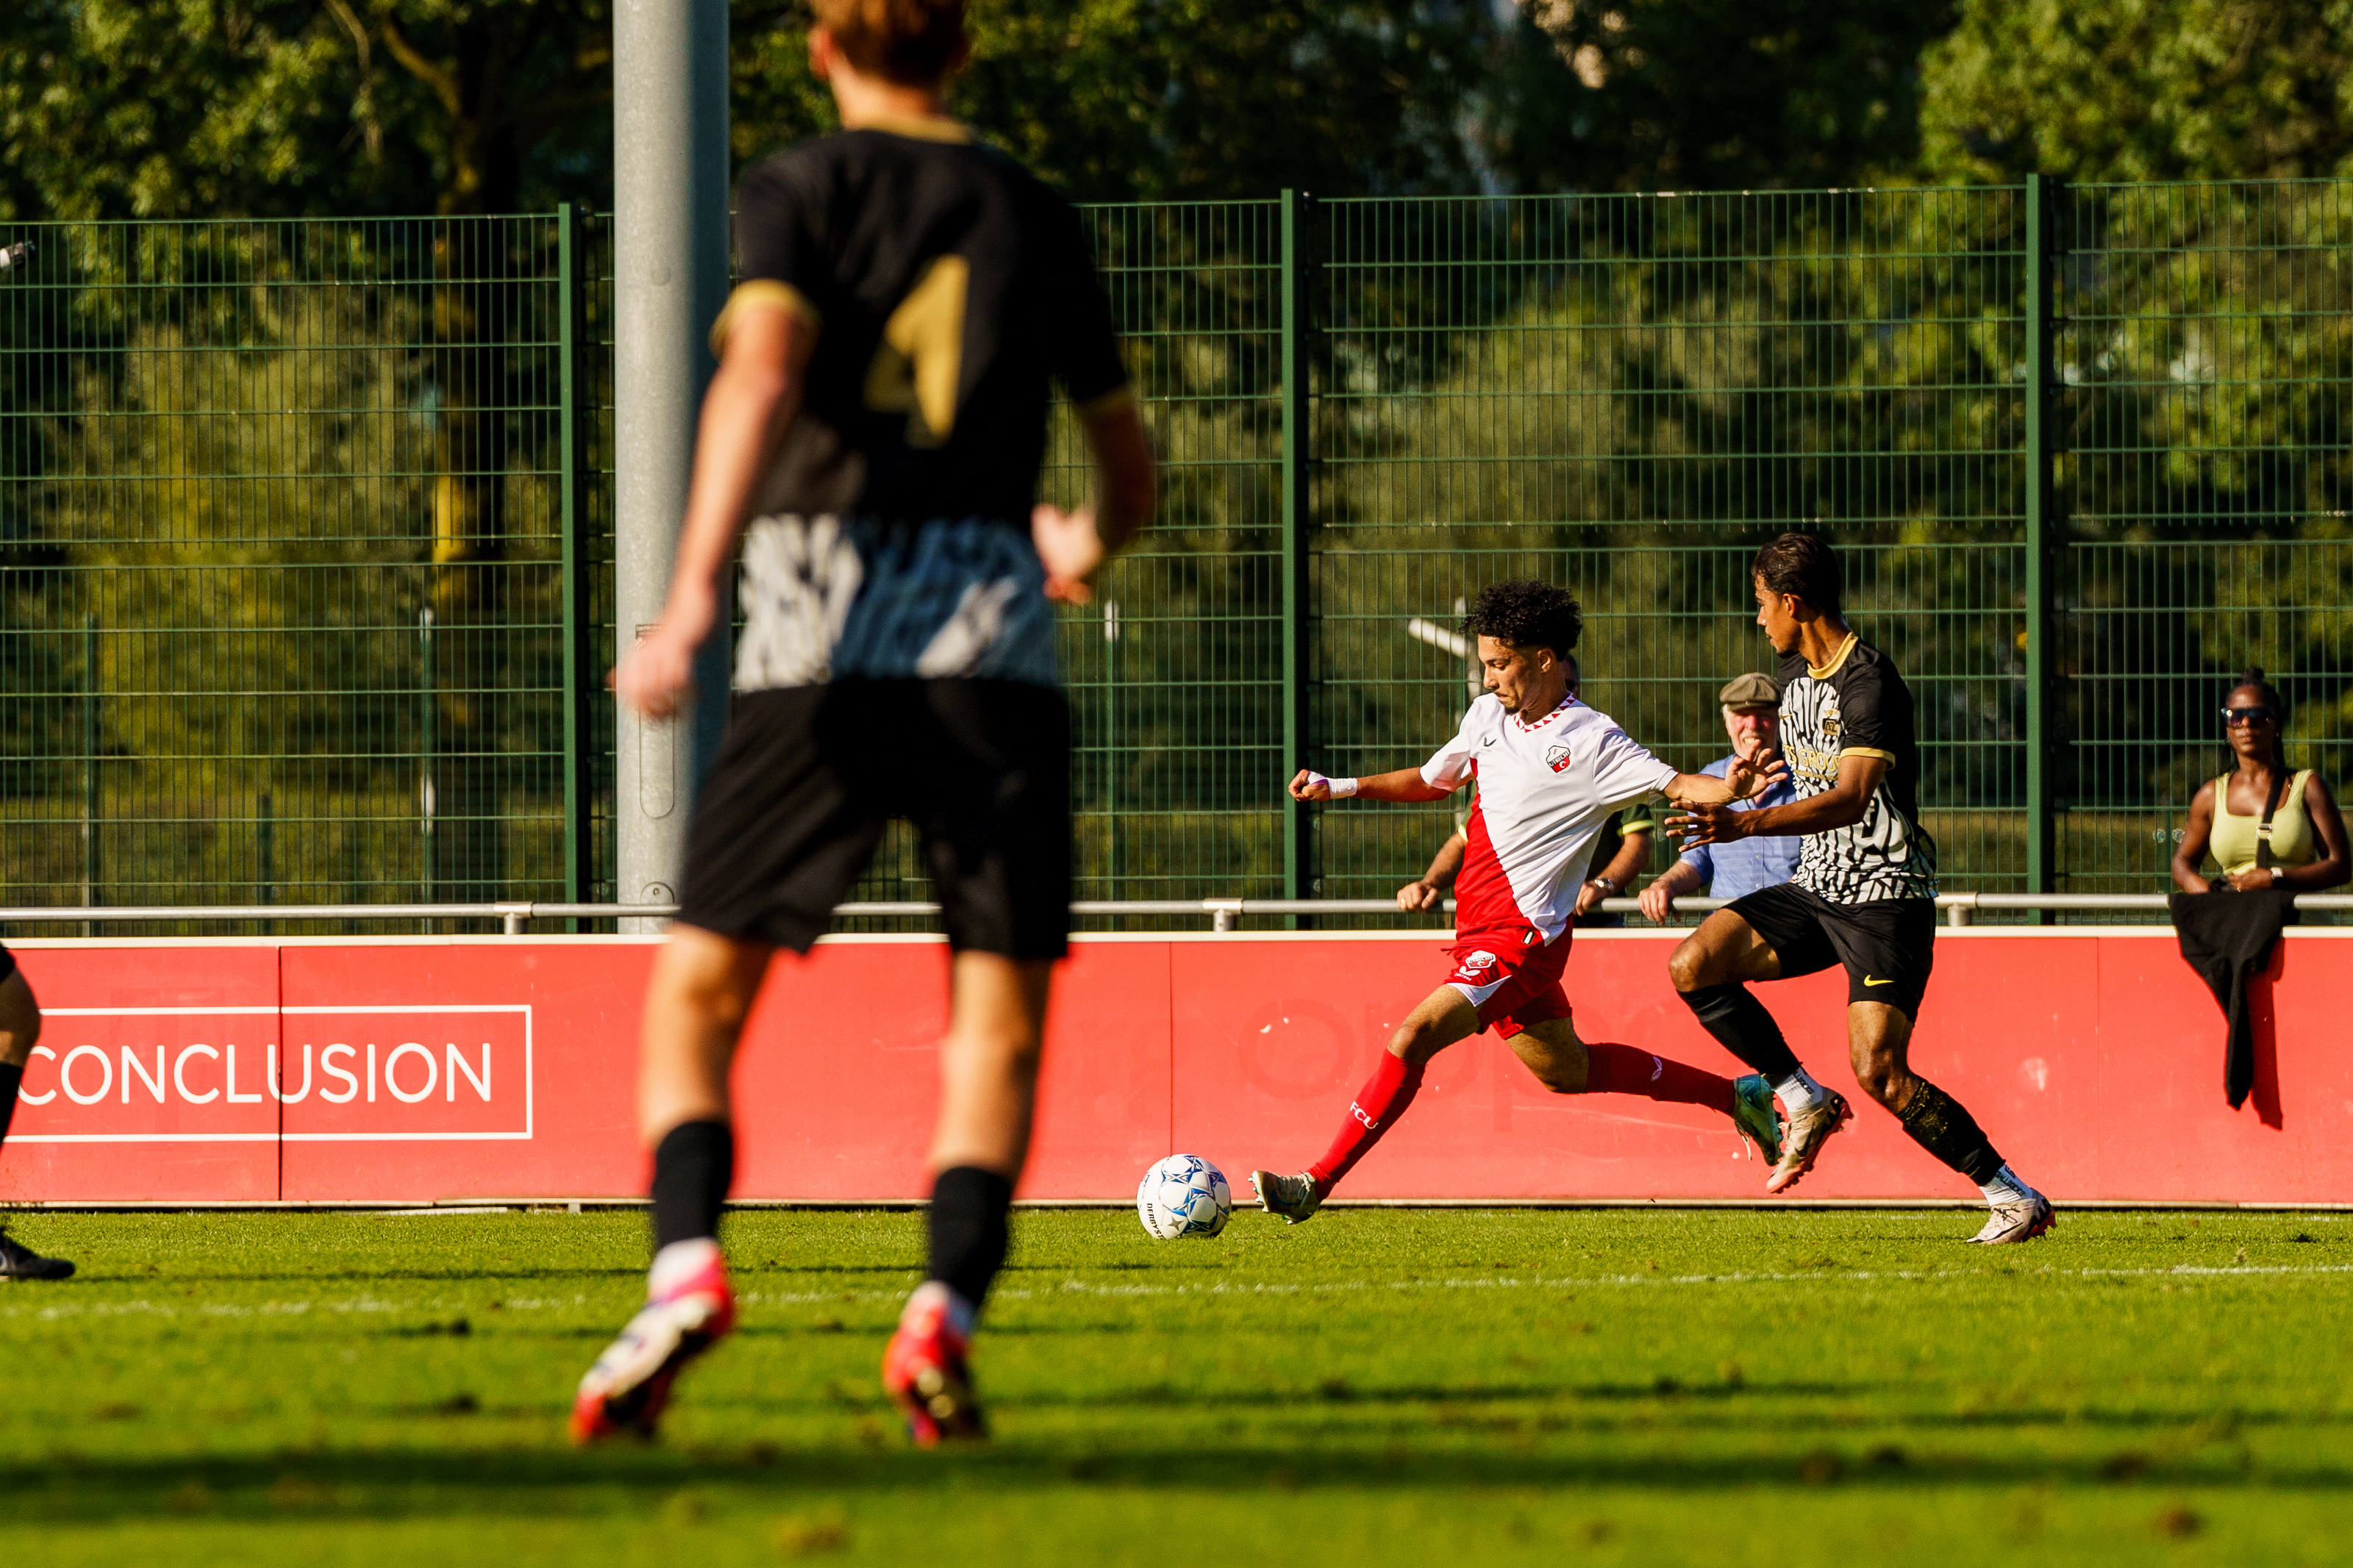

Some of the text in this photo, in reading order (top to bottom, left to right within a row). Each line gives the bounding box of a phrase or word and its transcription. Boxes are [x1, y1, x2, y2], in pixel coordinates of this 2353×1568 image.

[863, 254, 971, 449] 4
[18, 1042, 491, 1106] CONCLUSION
[1349, 1100, 1379, 1129] FCU
